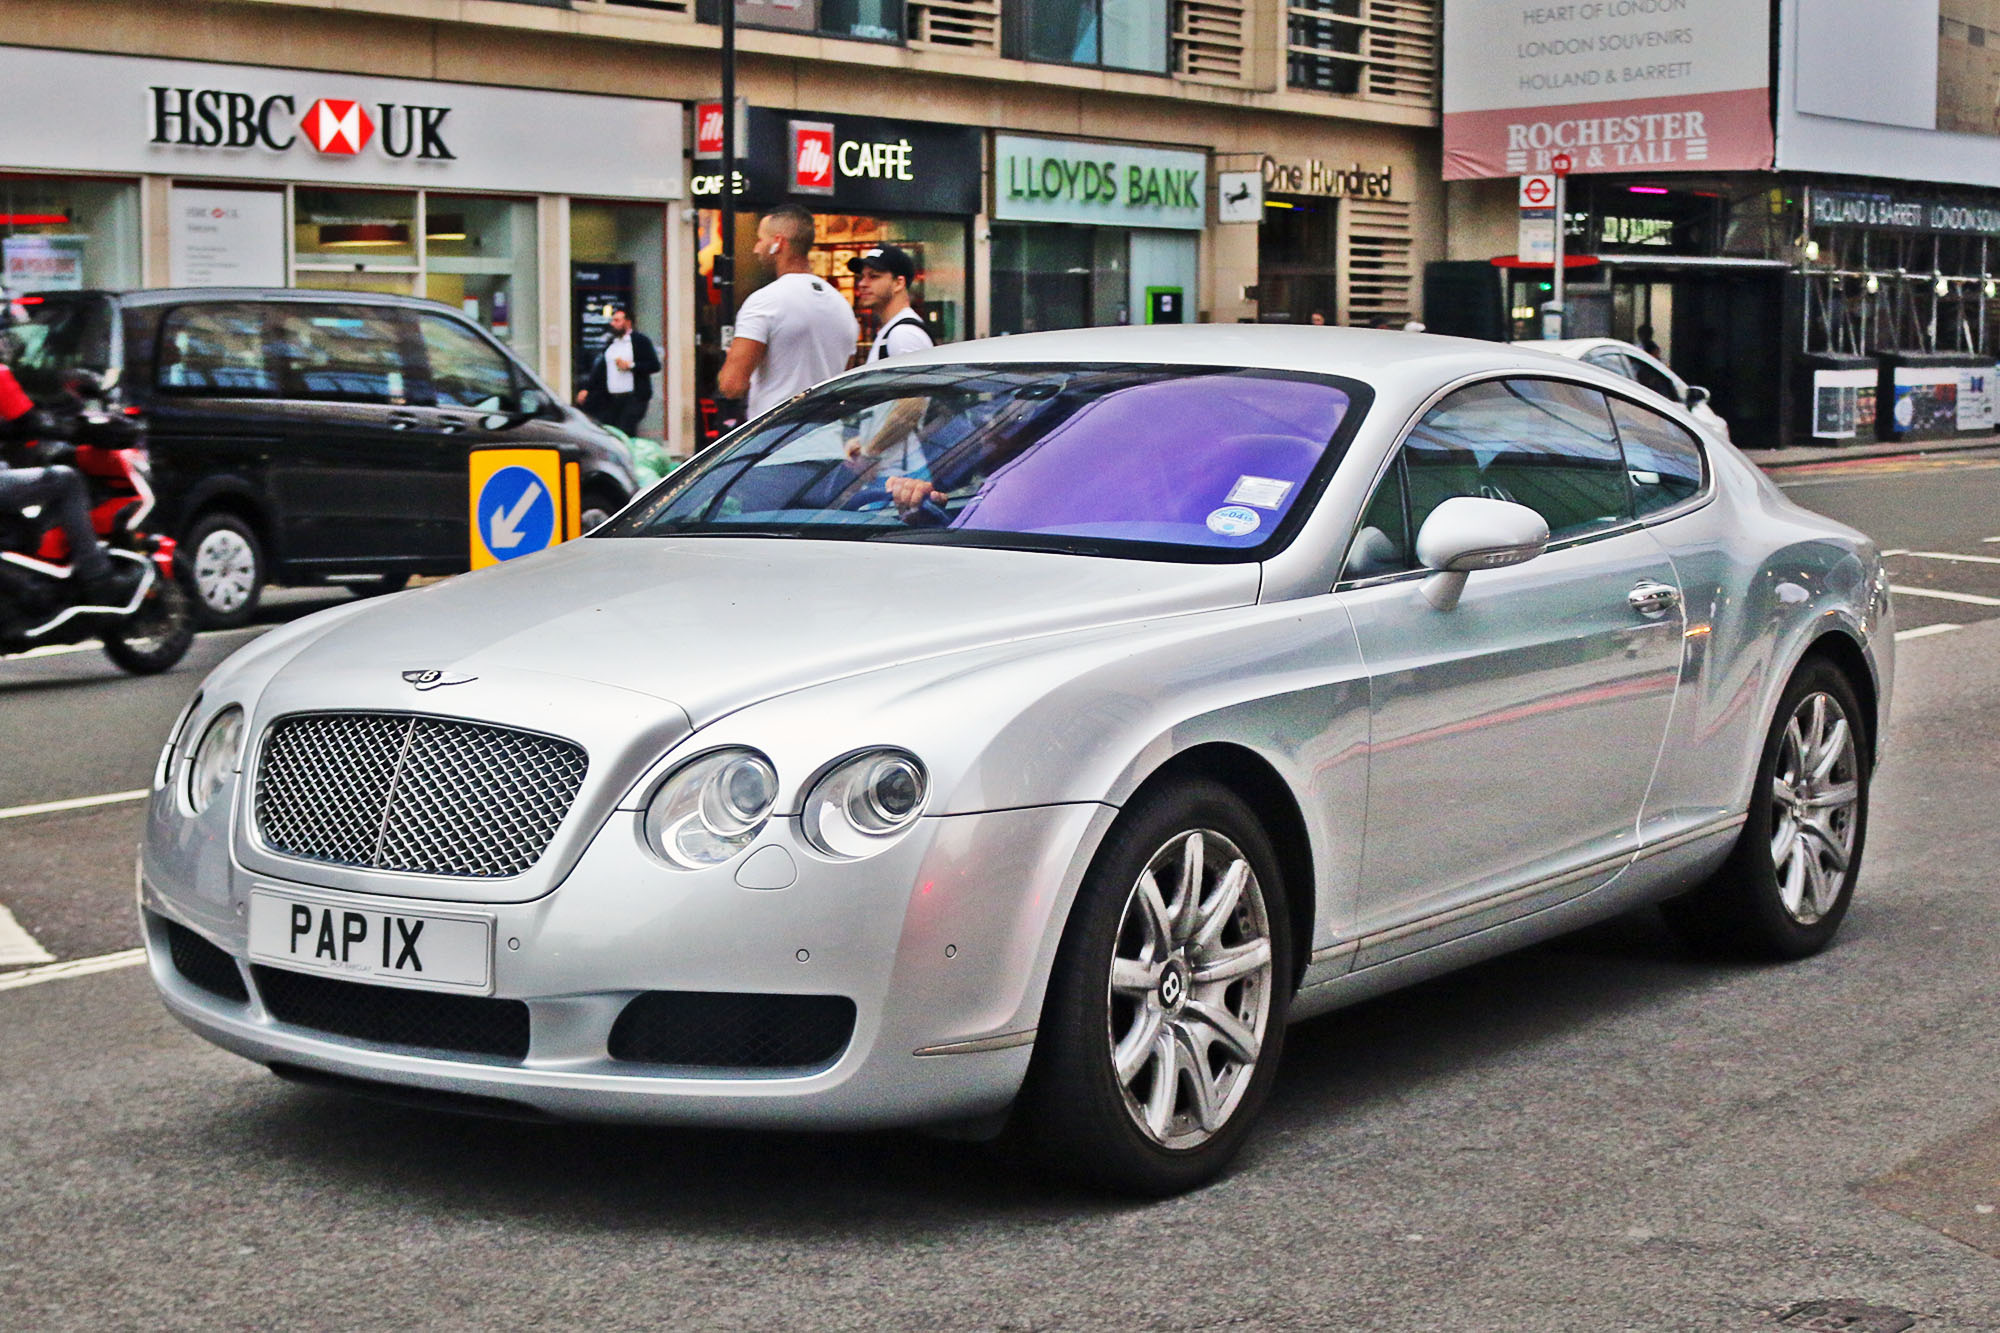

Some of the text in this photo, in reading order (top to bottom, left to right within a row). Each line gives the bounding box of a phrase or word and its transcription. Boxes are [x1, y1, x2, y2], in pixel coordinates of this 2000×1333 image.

[1522, 0, 1686, 25] HEART OF LONDON
[1517, 28, 1693, 59] LONDON SOUVENIRS
[1519, 61, 1693, 91] HOLLAND & BARRETT
[150, 86, 457, 159] HSBC UK
[1508, 110, 1708, 151] ROCHESTER
[798, 138, 830, 182] illy
[1586, 146, 1606, 169] &
[1614, 141, 1676, 167] TALL
[1009, 155, 1199, 208] LLOYDS BANK
[1262, 155, 1391, 197] One Hundred
[1814, 197, 1868, 223] HOLLAND
[1879, 201, 1922, 228] BARRETT
[290, 903, 367, 962] PAP
